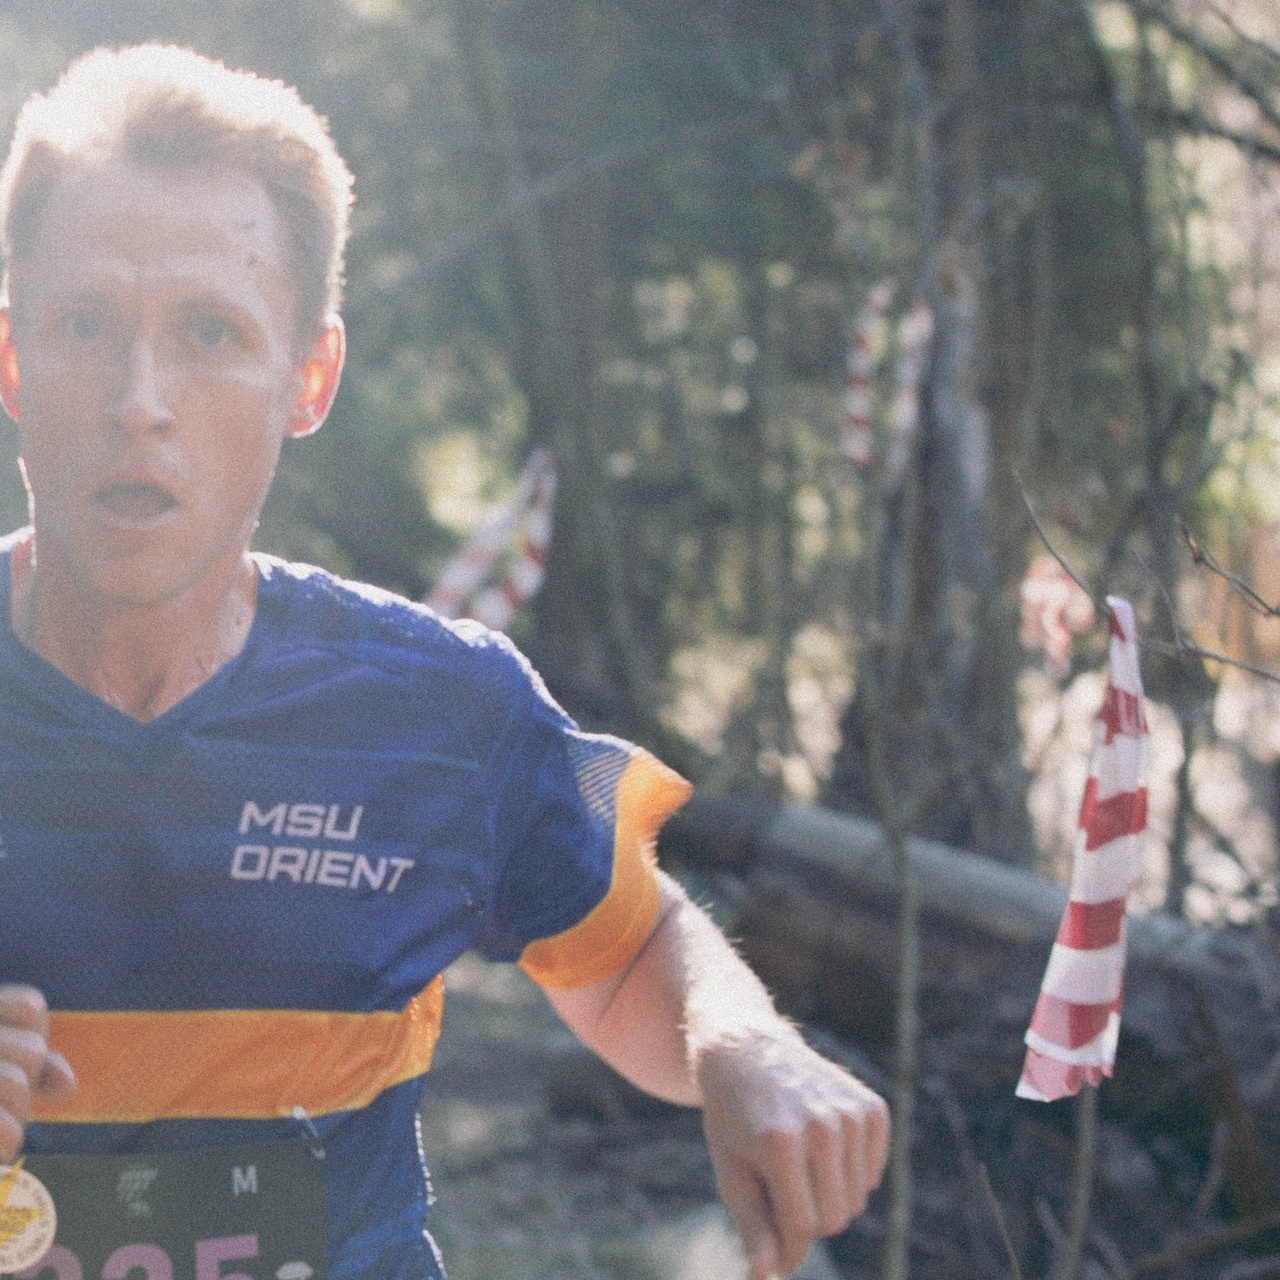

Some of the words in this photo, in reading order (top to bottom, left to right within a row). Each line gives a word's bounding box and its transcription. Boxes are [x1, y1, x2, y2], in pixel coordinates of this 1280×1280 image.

[238, 800, 364, 841] MSU
[230, 844, 417, 893] ORIENT
[232, 1164, 258, 1196] M
